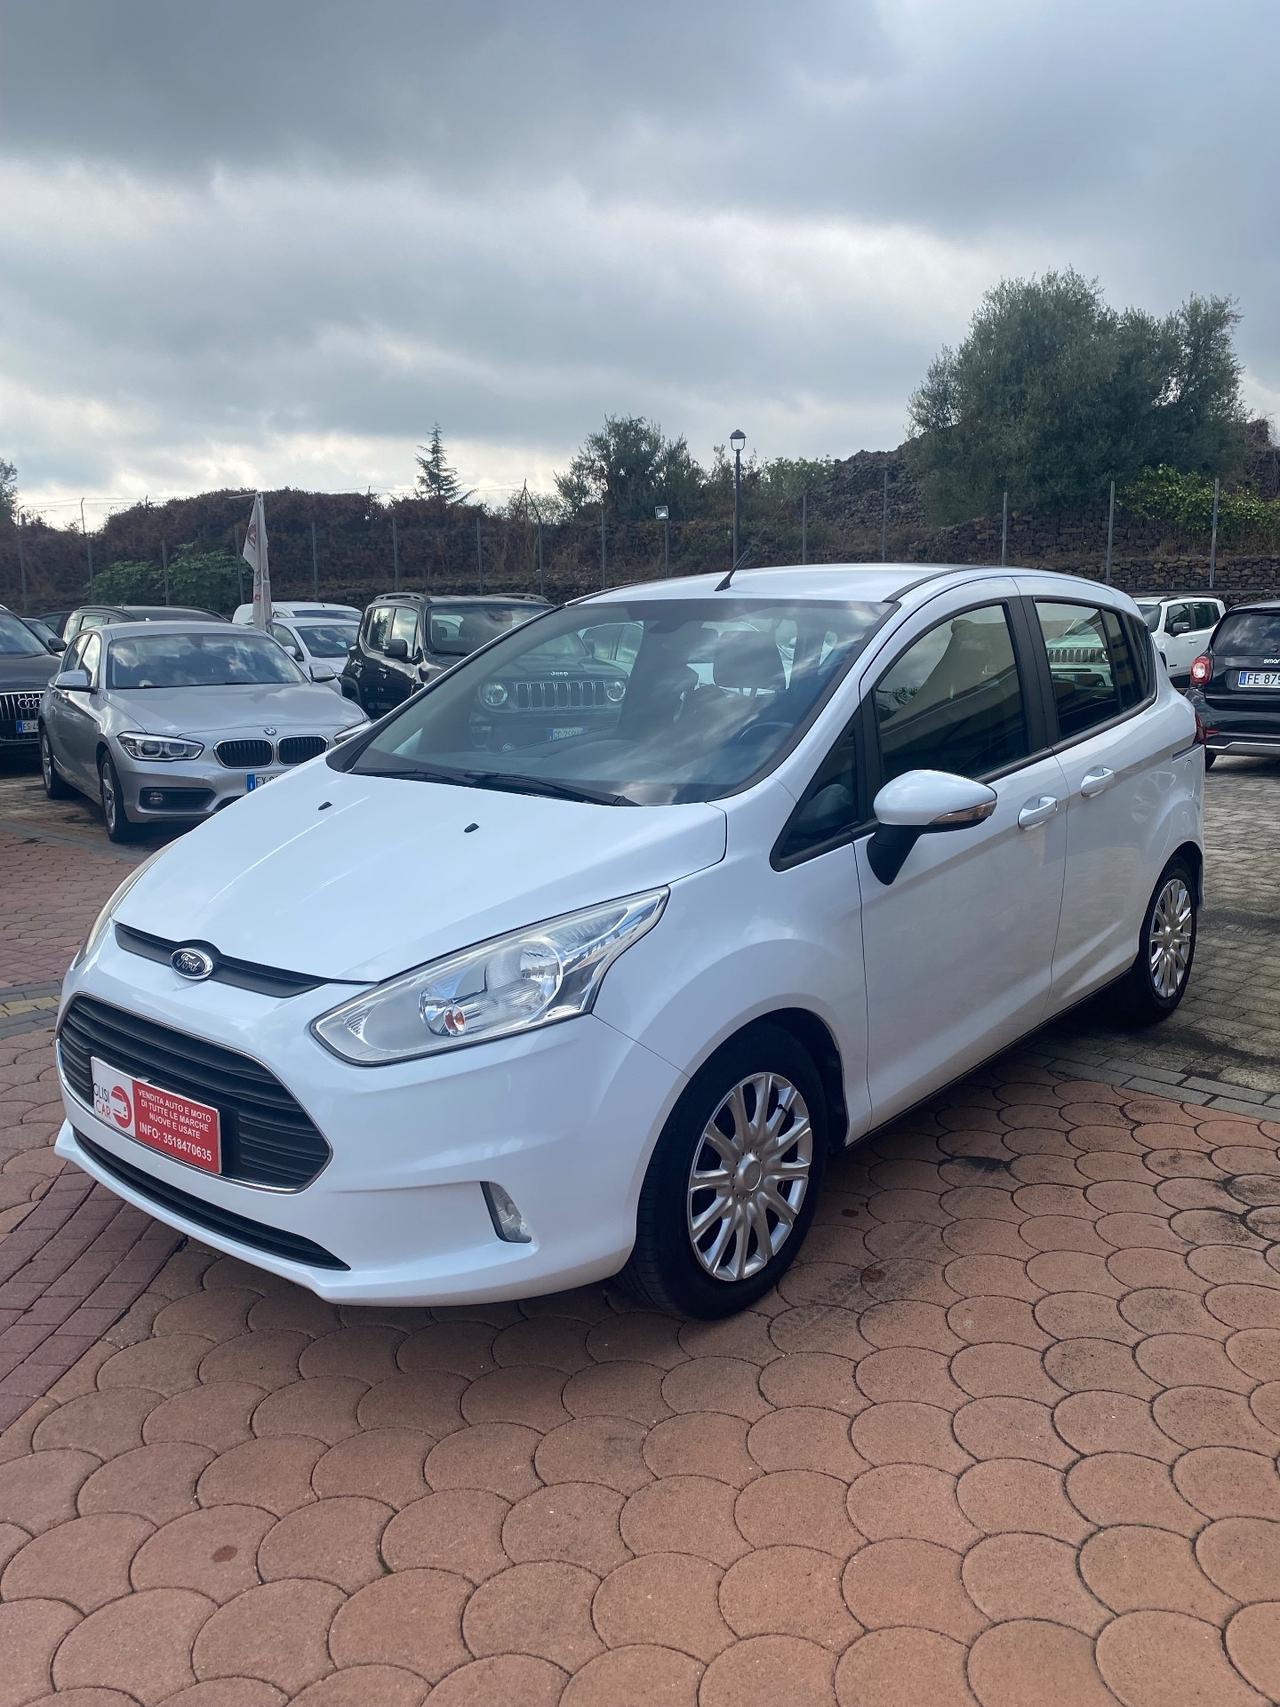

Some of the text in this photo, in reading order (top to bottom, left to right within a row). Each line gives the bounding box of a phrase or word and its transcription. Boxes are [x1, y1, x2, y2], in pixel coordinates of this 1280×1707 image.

[1247, 673, 1261, 685] FE
[176, 952, 201, 972] Ford
[137, 1088, 212, 1123] VENDITA AUTO E MOTO
[141, 1099, 209, 1132] DI TUTTE LE MARCHE
[149, 1112, 201, 1139] NUOVE E USATE
[139, 1121, 212, 1162] INFO: 3518470635
